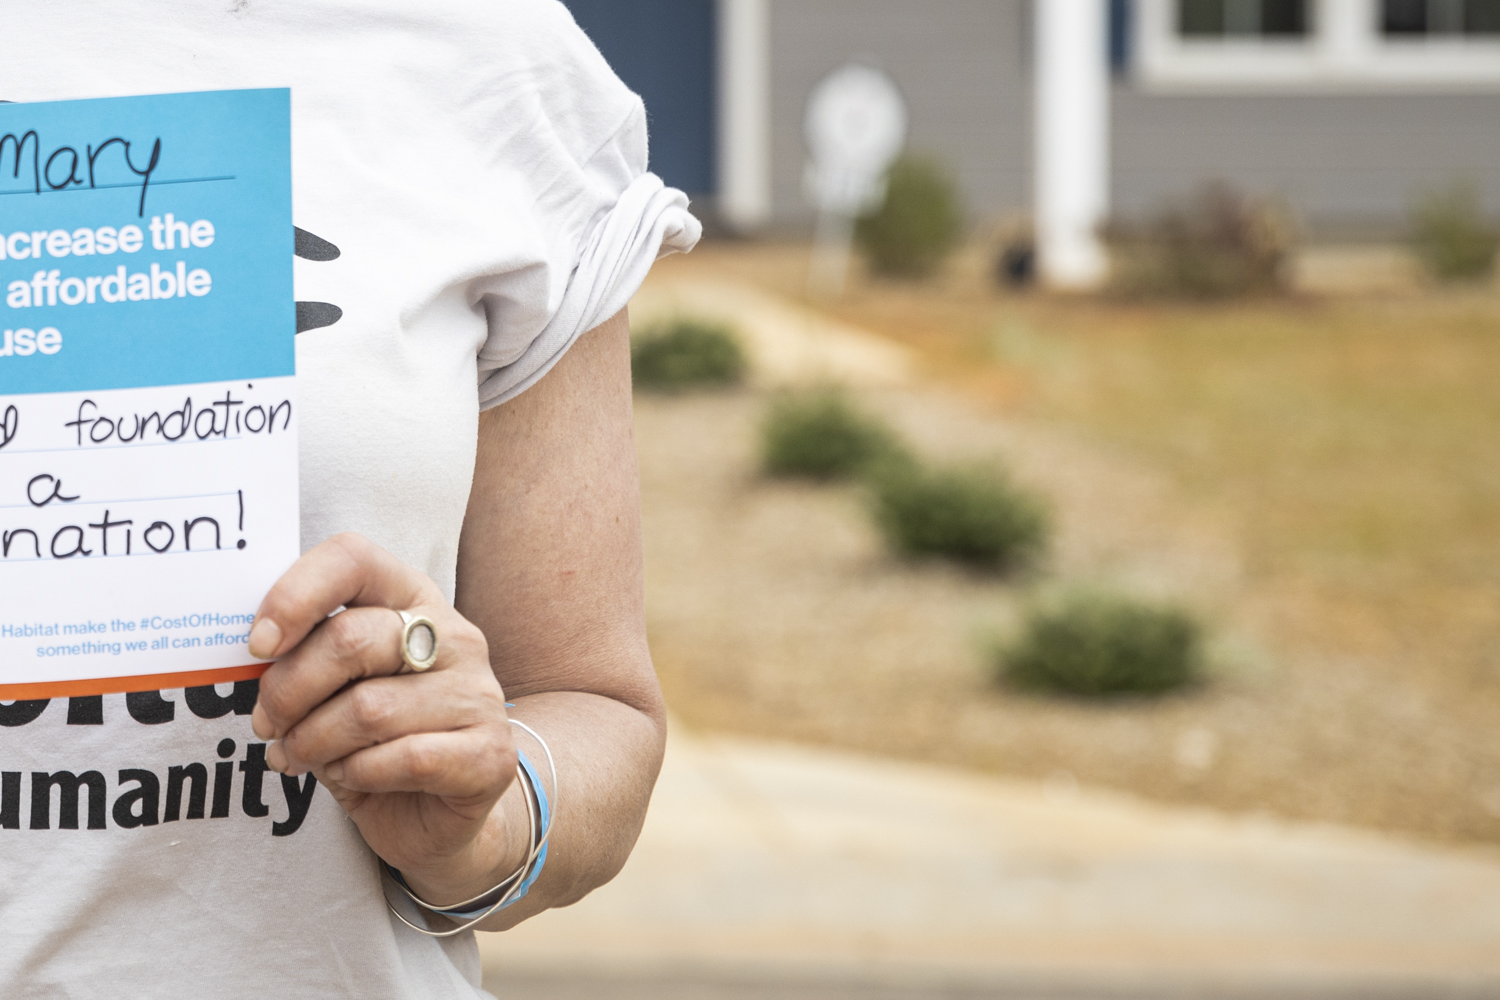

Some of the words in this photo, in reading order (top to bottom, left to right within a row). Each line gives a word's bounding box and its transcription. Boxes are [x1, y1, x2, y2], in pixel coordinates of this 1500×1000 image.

[149, 213, 215, 251] the
[6, 261, 211, 308] affordable
[65, 383, 291, 446] foundation
[27, 473, 80, 507] a
[3, 490, 247, 559] nation!
[2, 623, 60, 638] Habitat
[63, 620, 107, 635] make
[111, 619, 136, 632] the
[140, 613, 254, 630] #CostOfHome
[37, 639, 121, 657] something
[125, 640, 147, 652] we
[151, 637, 169, 650] all
[172, 637, 201, 649] can
